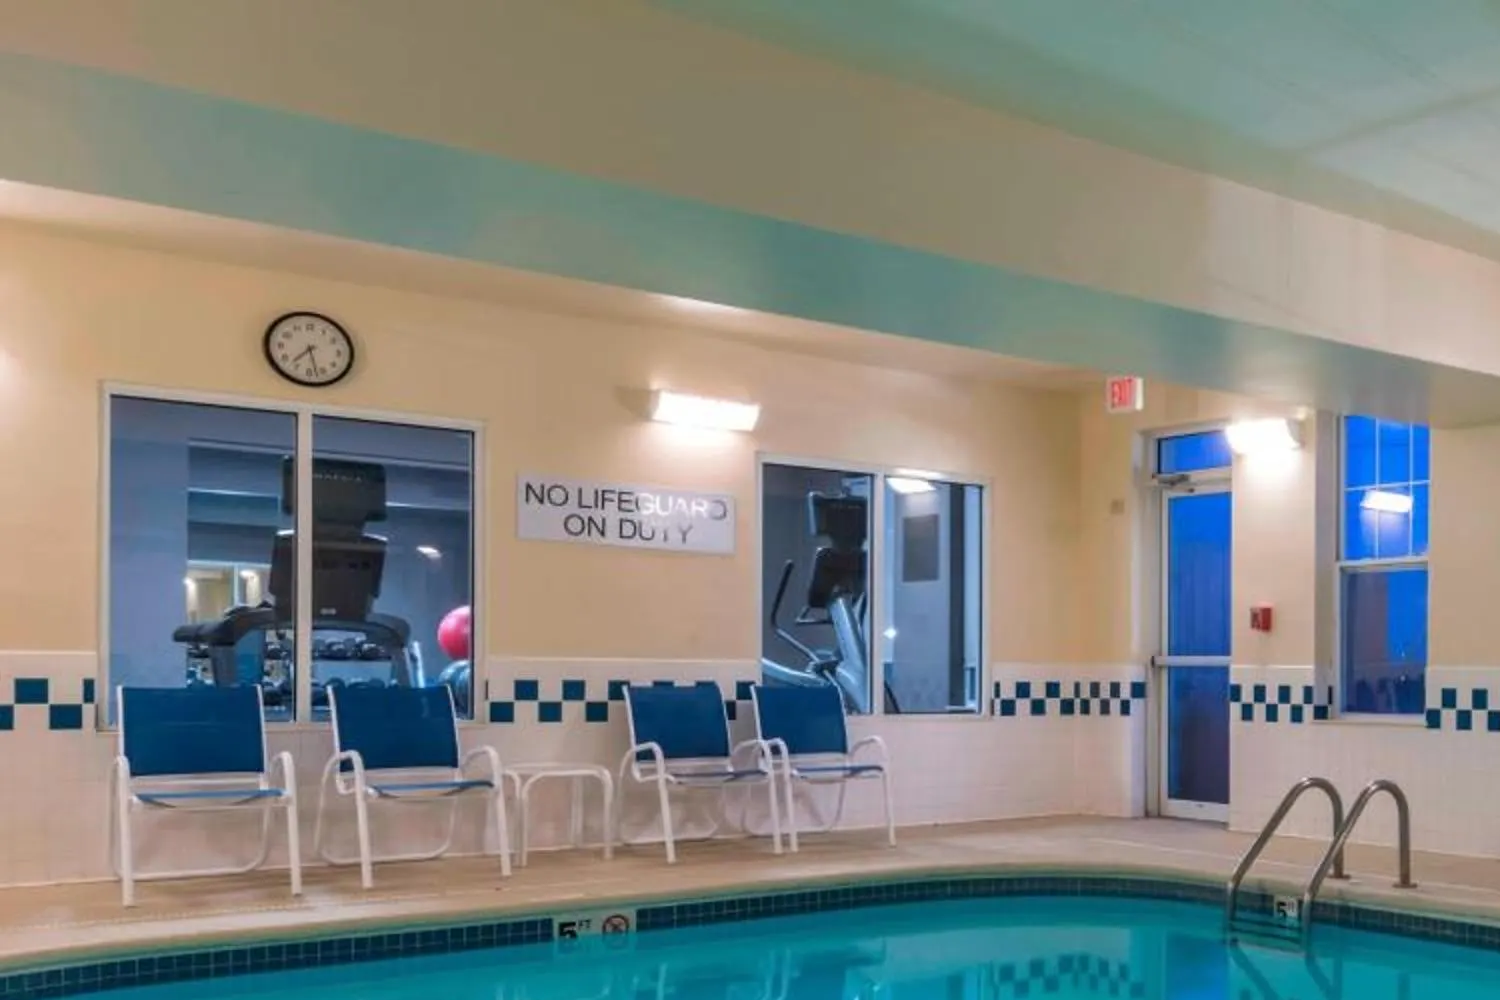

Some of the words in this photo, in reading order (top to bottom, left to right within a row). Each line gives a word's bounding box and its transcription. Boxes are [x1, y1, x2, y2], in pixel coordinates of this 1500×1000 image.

[1111, 380, 1133, 408] EXIT
[524, 482, 569, 507] NO
[577, 487, 728, 520] LIFEGUARD
[563, 513, 606, 538] ON
[619, 518, 694, 544] DUTY
